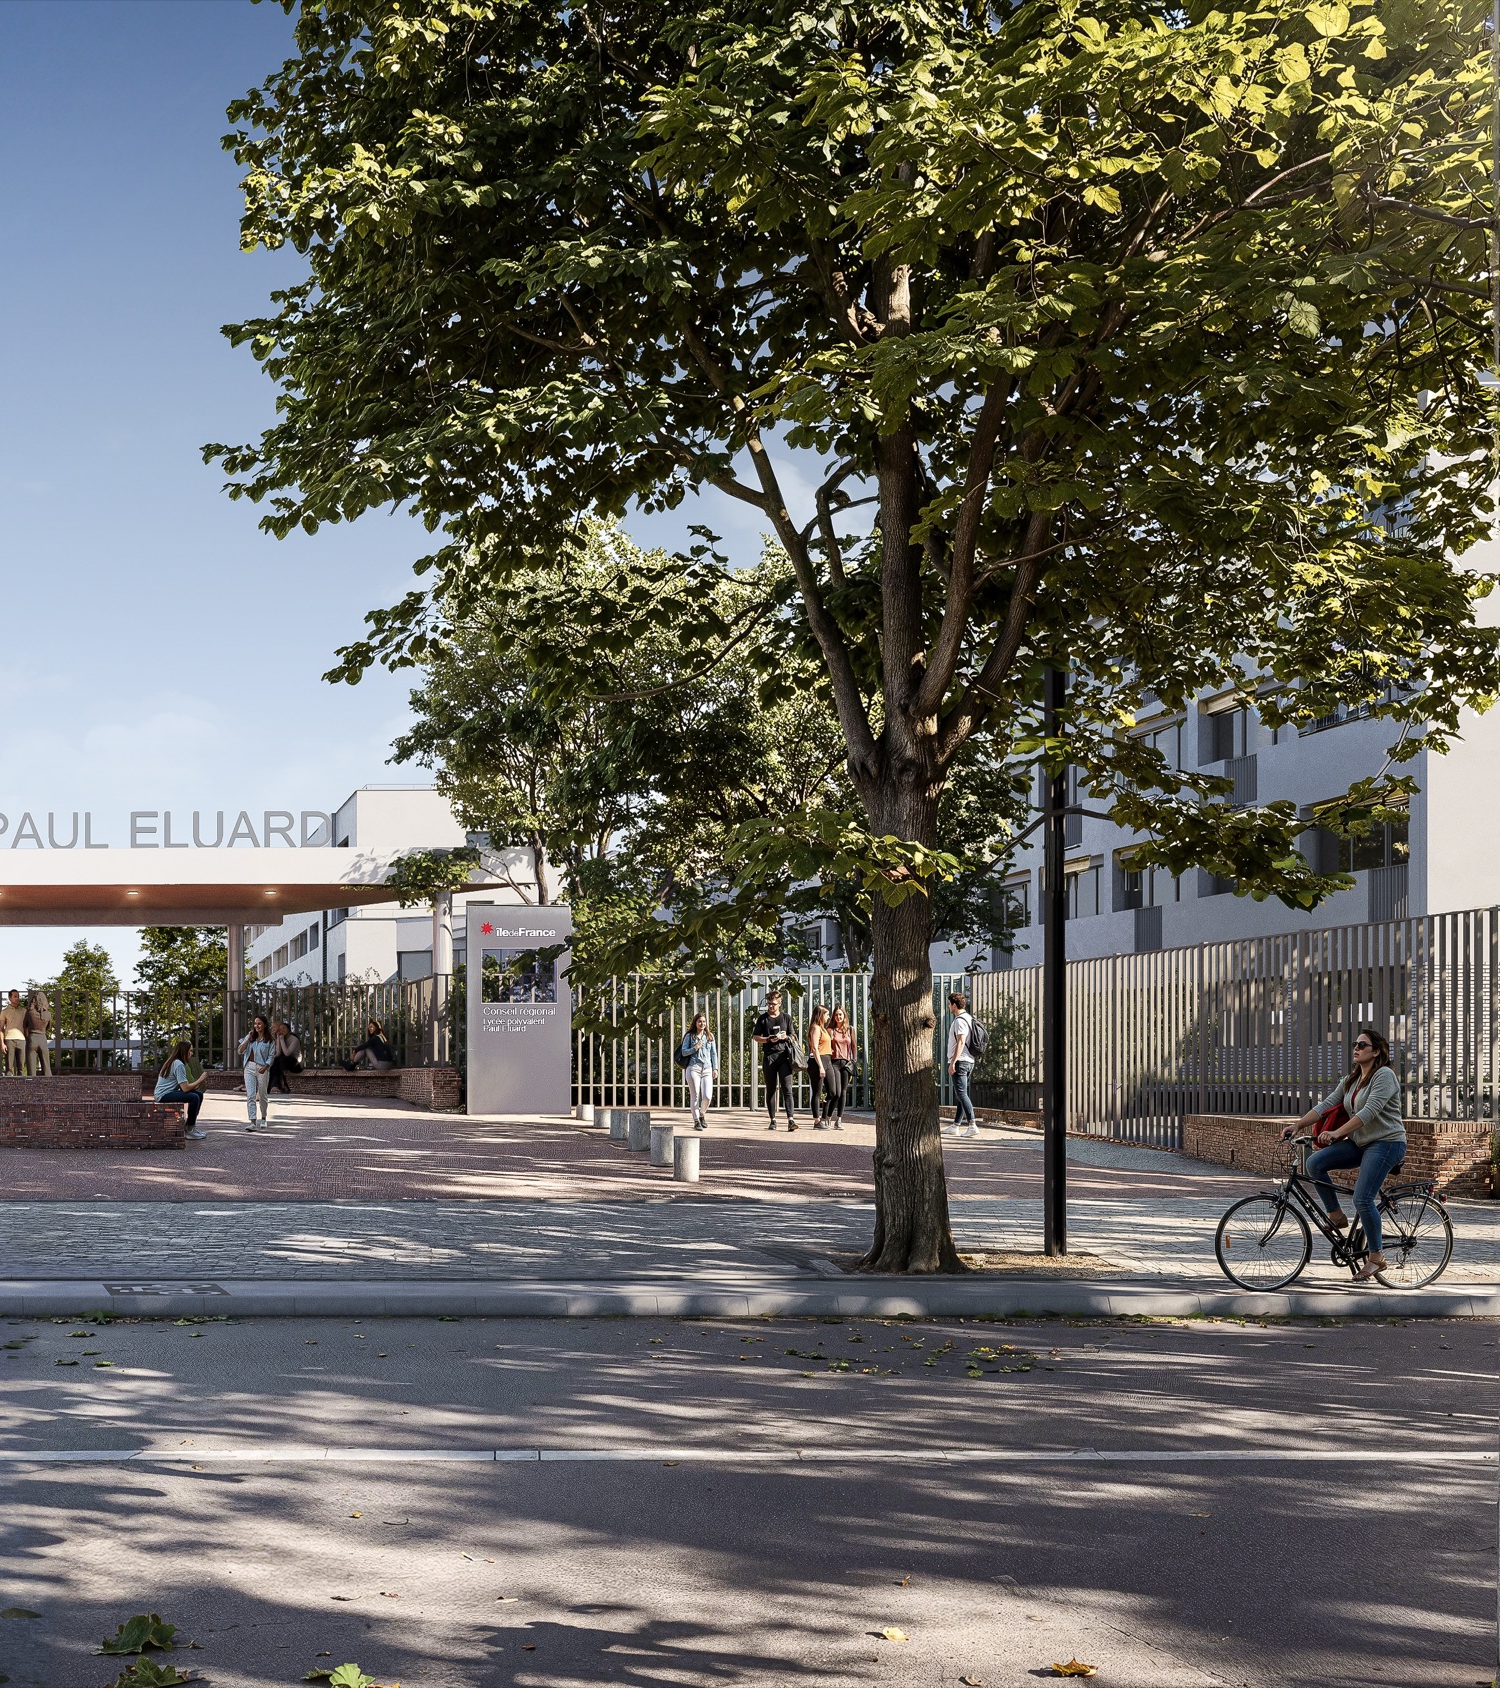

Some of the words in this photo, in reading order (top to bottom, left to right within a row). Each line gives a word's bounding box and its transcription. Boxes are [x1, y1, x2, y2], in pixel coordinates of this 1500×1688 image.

[130, 810, 333, 848] ELUARD
[483, 1007, 517, 1016] Conseil
[519, 1007, 556, 1017] régional
[483, 1018, 506, 1026] Lycée
[507, 1018, 545, 1027] polyvalent
